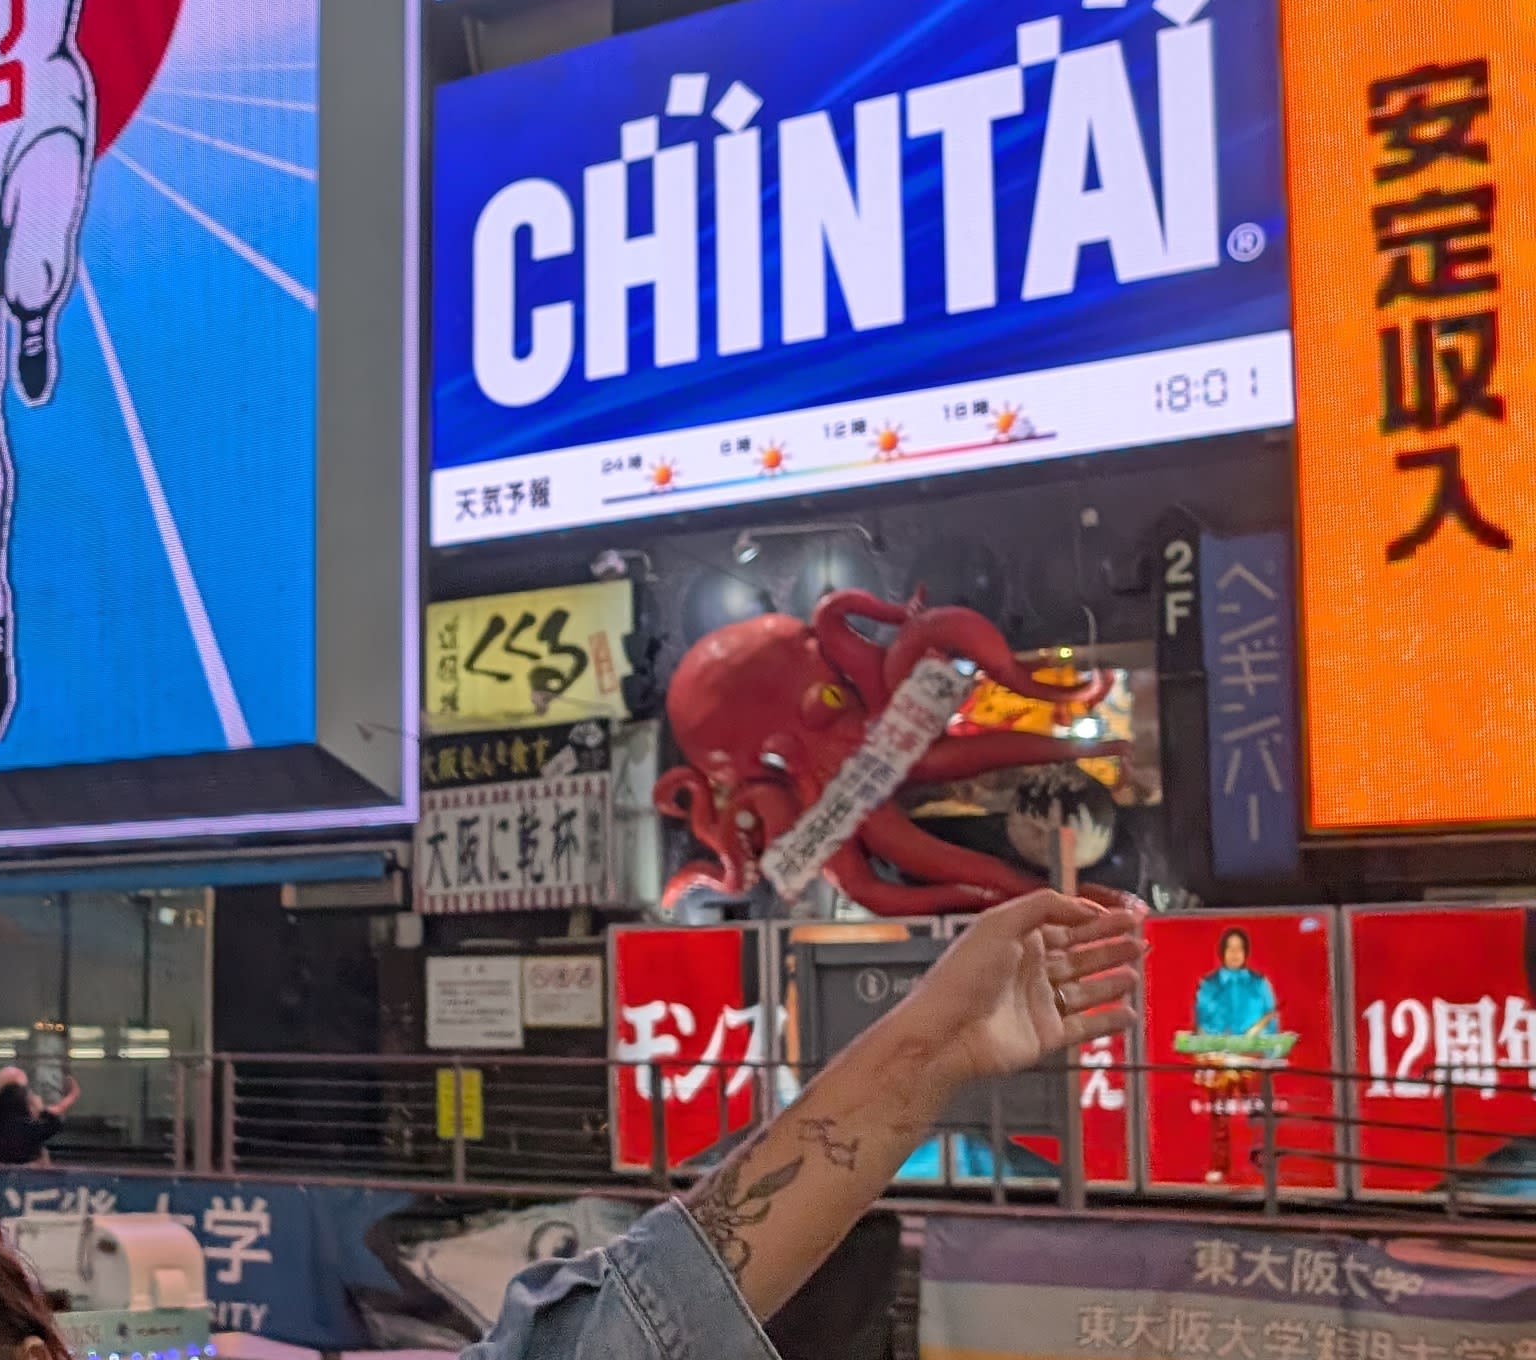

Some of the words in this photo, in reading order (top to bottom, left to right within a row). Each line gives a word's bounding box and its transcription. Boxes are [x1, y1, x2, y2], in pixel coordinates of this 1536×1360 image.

[1366, 57, 1514, 565] 安定収入
[1154, 366, 1260, 413] 18:01
[454, 476, 552, 522] 天気予報
[1164, 540, 1194, 637] 2F
[464, 607, 590, 696] くくる
